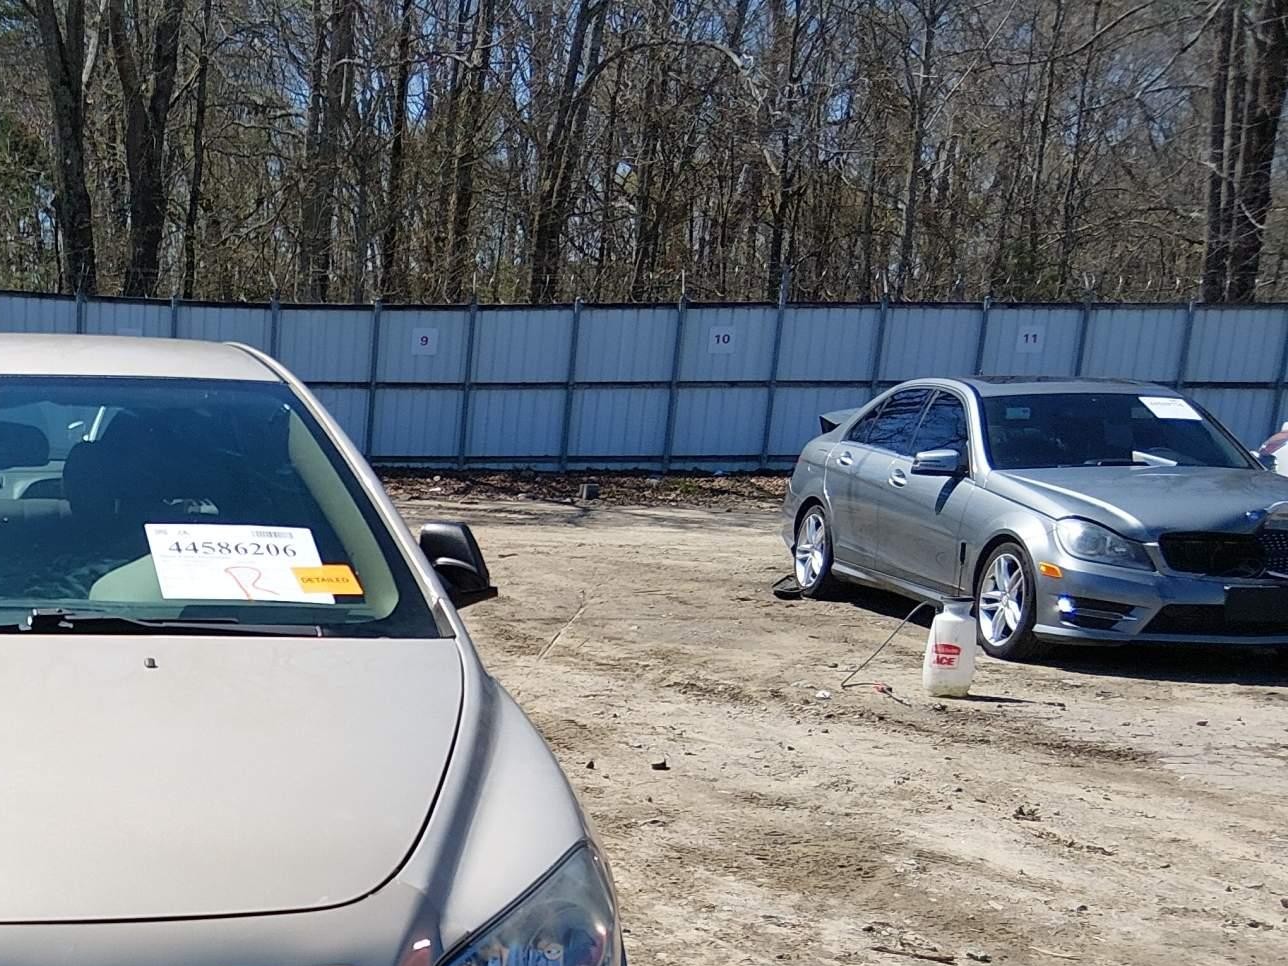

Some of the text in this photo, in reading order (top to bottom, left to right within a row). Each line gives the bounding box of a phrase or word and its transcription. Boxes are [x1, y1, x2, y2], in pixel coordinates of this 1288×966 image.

[420, 335, 429, 346] 9
[715, 334, 731, 344] 10
[1023, 334, 1037, 343] 11
[168, 541, 297, 557] 44586206
[300, 576, 350, 584] DETAILED
